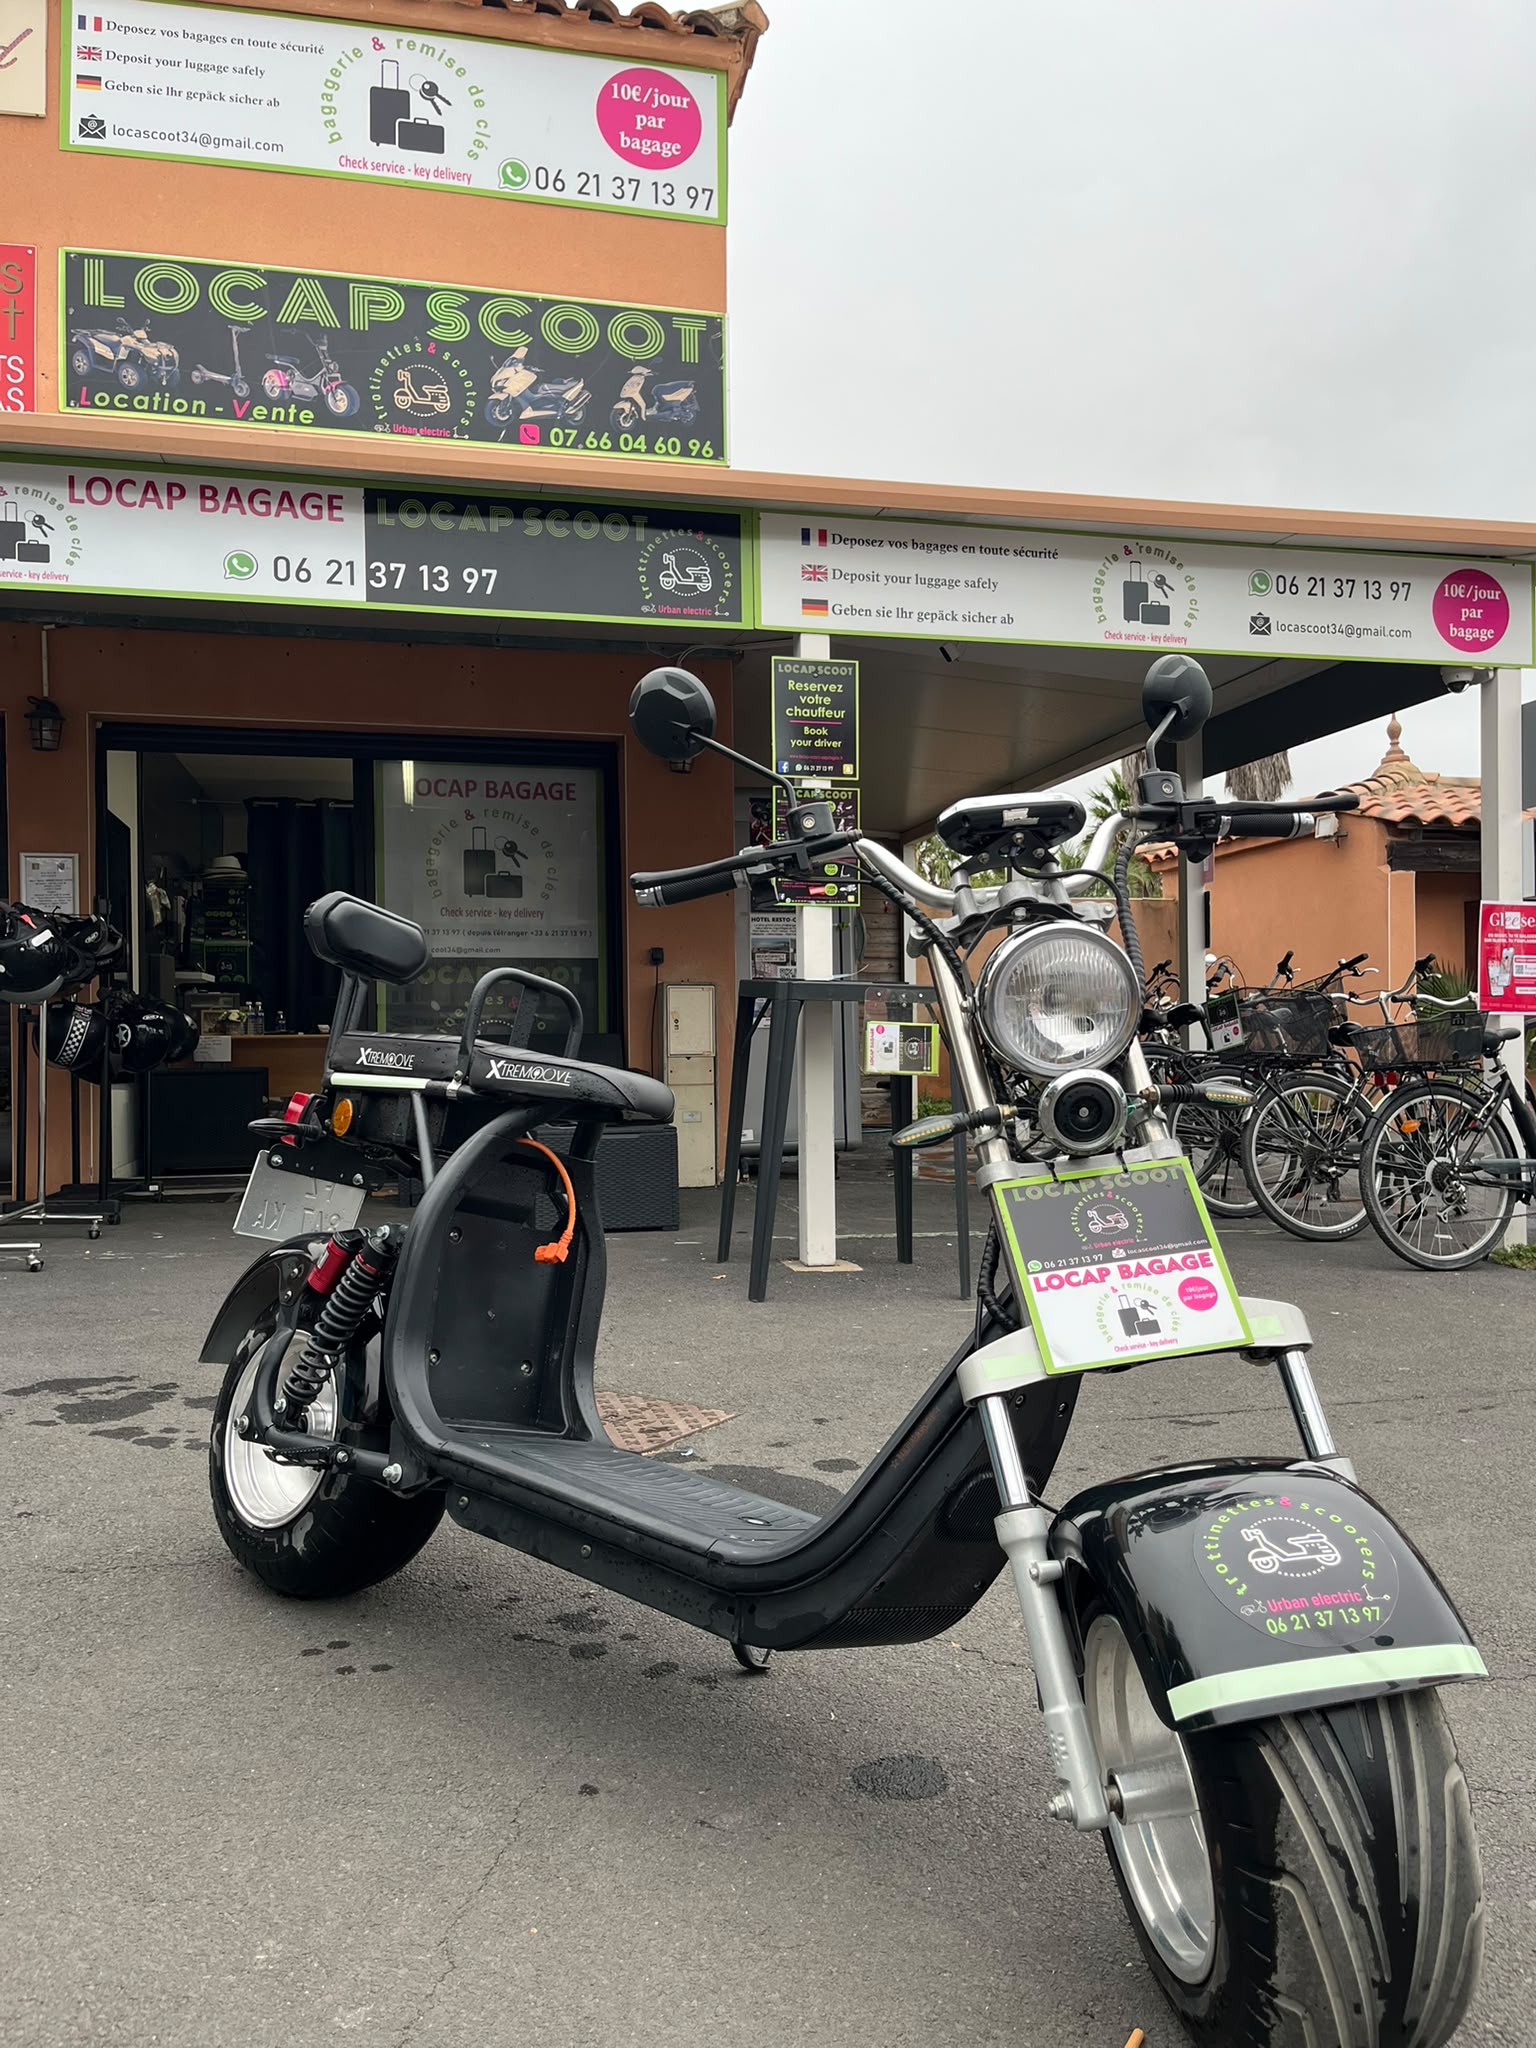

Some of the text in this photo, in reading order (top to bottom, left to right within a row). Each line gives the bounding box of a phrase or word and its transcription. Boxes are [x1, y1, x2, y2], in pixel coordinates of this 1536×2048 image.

[106, 20, 325, 55] Deposez vos bagages en toute sécurité
[105, 50, 265, 78] Deposit your luggage safely
[104, 79, 143, 94] Geben
[146, 83, 163, 96] sie
[186, 88, 226, 106] gepäck
[229, 91, 263, 106] sicher
[266, 97, 280, 108] ab
[321, 36, 491, 160] bagagerie & remise de clés
[610, 82, 691, 112] 10€/jour
[636, 113, 666, 131] par
[113, 123, 284, 153] locascoot34@gmail.com
[620, 131, 682, 158] bagage
[339, 155, 472, 186] Check service key delivery
[535, 166, 714, 212] 06 21 37 13 97
[84, 258, 706, 363] LOCAP SCOOT
[428, 342, 436, 354] &
[442, 352, 476, 426] scooters
[80, 386, 315, 424] Location Vente
[393, 424, 451, 437] Urban electric
[550, 428, 714, 458] 07 66 04 60 96
[68, 475, 648, 542] LOCAP BAGAGE LOCAP SCOOT
[14, 486, 82, 566] remise de clés
[831, 533, 1058, 560] Deposez vos bagages en toute sécurité
[273, 556, 498, 595] 06 21 37 13 97
[638, 529, 734, 604] trottinettes & scooters
[831, 568, 999, 592] Deposit your luggage safely
[1093, 545, 1200, 628] bagagerie & remise de clés
[1276, 575, 1412, 602] 06 21 37 13 97
[1442, 583, 1502, 603] 10€/jour
[658, 604, 712, 616] Urban electric
[831, 603, 872, 618] Geben
[876, 606, 892, 618] sie
[917, 608, 958, 624] gepäck
[962, 610, 997, 624] sicher
[1000, 613, 1014, 626] ab
[1461, 606, 1484, 622] par
[1104, 630, 1188, 646] Check service key delivery
[1276, 620, 1412, 639] locascoot34@gmail.com
[1449, 624, 1495, 642] bagage
[778, 664, 854, 676] LOCAP SCOOT
[788, 680, 844, 692] Reservez
[800, 694, 832, 705] votre
[786, 706, 846, 718] chauffeur
[790, 738, 842, 748] your driver
[804, 726, 828, 736] Book
[415, 778, 576, 801] OCAP BAGAGE
[426, 809, 558, 900] bagagerie & remise de clés
[440, 907, 544, 920] Check service key delivery
[1011, 1166, 1180, 1202] LOCAP SCOOT
[1070, 1191, 1144, 1242] trottinettes scooters
[1032, 1252, 1214, 1292] LOCAP BAGAGE
[1044, 1261, 1056, 1269] 06
[1058, 1259, 1067, 1267] 21
[1068, 1258, 1079, 1266] 37
[1081, 1256, 1091, 1264] 13
[1093, 1254, 1104, 1262] 97
[1096, 1293, 1113, 1344] bagagerie
[1122, 1282, 1159, 1295] remise
[1162, 1296, 1172, 1307] de
[1203, 1496, 1375, 1596] trottinettes & scooters
[1266, 1590, 1362, 1614] Urban electric
[1266, 1606, 1381, 1635] 06 21 37 13 97
